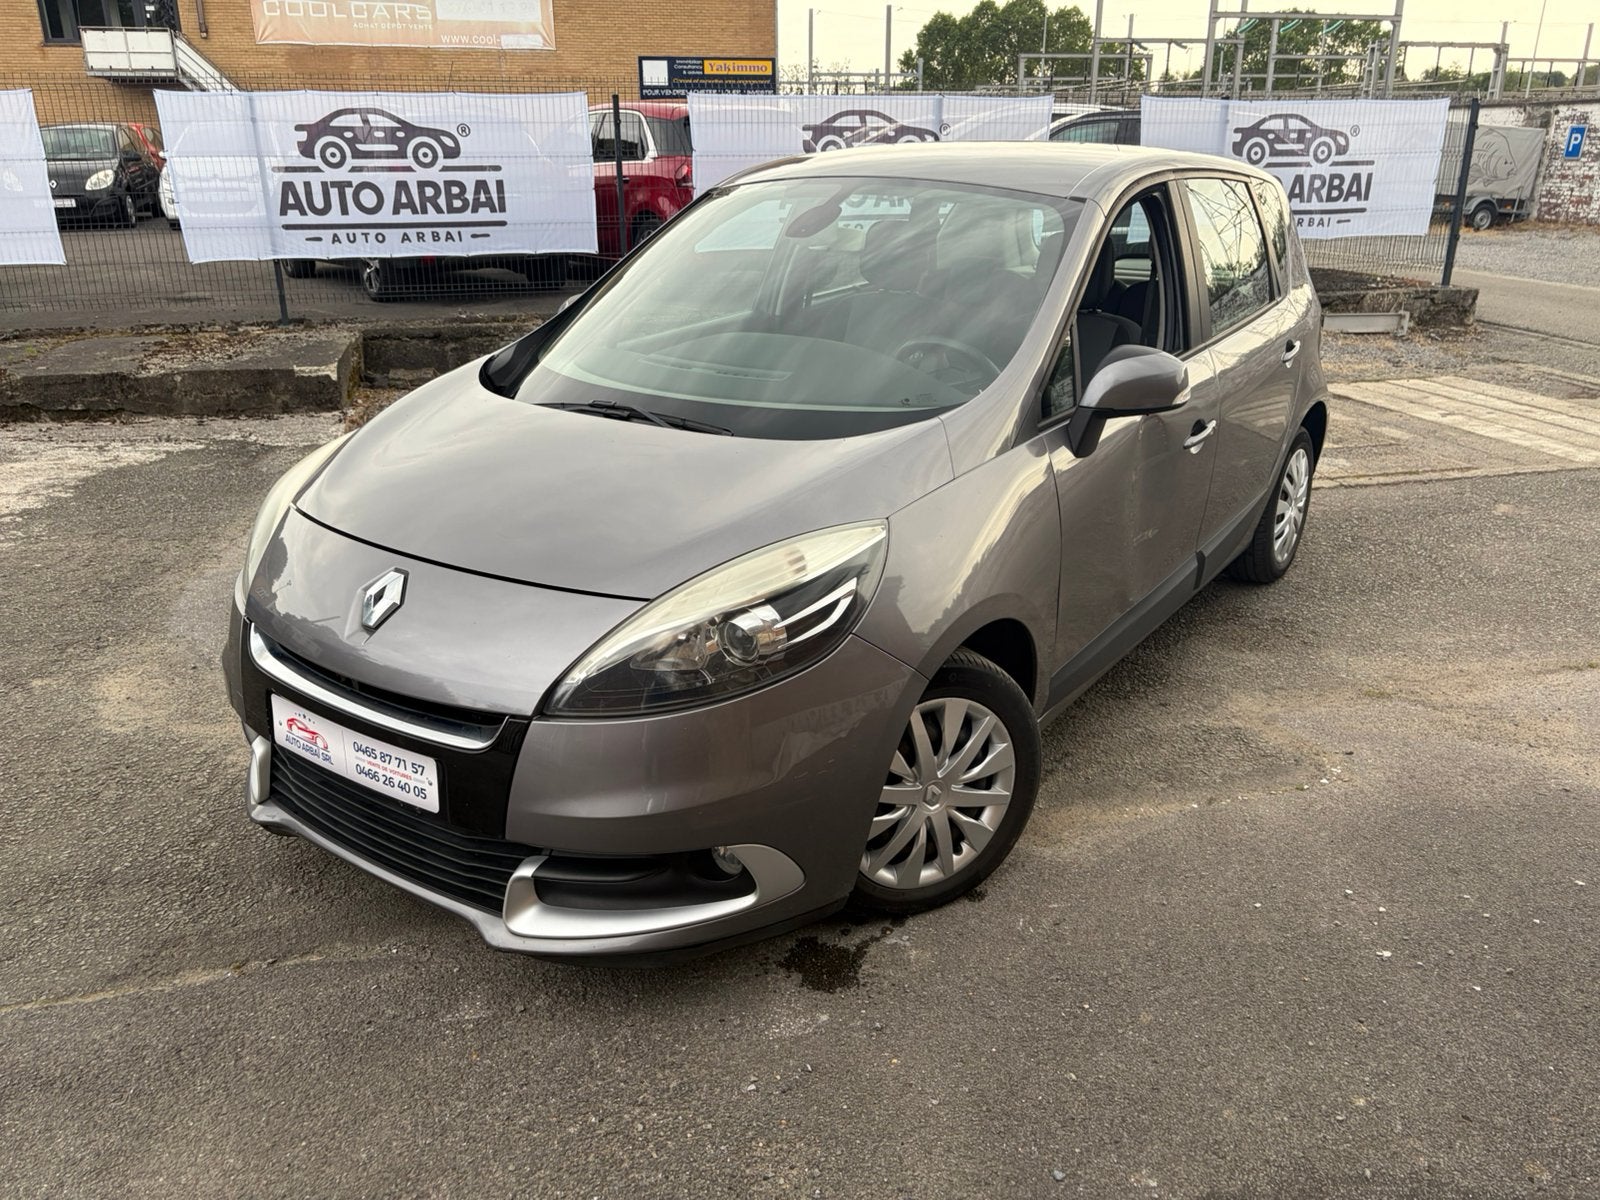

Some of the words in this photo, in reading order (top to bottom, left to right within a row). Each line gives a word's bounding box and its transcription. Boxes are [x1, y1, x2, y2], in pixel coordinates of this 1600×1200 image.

[708, 62, 768, 73] Yakimmo
[1569, 133, 1582, 151] P
[1288, 172, 1373, 203] ARBAI
[279, 180, 384, 216] AUTO
[392, 179, 507, 215] ARBAI
[1296, 217, 1331, 227] RBAI
[331, 232, 386, 245] AUTO
[401, 231, 463, 244] ARBAI
[285, 734, 301, 749] AUTO
[353, 741, 377, 759] 0465
[380, 751, 392, 765] 87
[395, 757, 407, 771] 71
[411, 762, 425, 776] 57
[355, 763, 380, 782] 0466
[382, 774, 395, 788] 26
[397, 780, 410, 794] 40
[413, 785, 427, 800] 05
